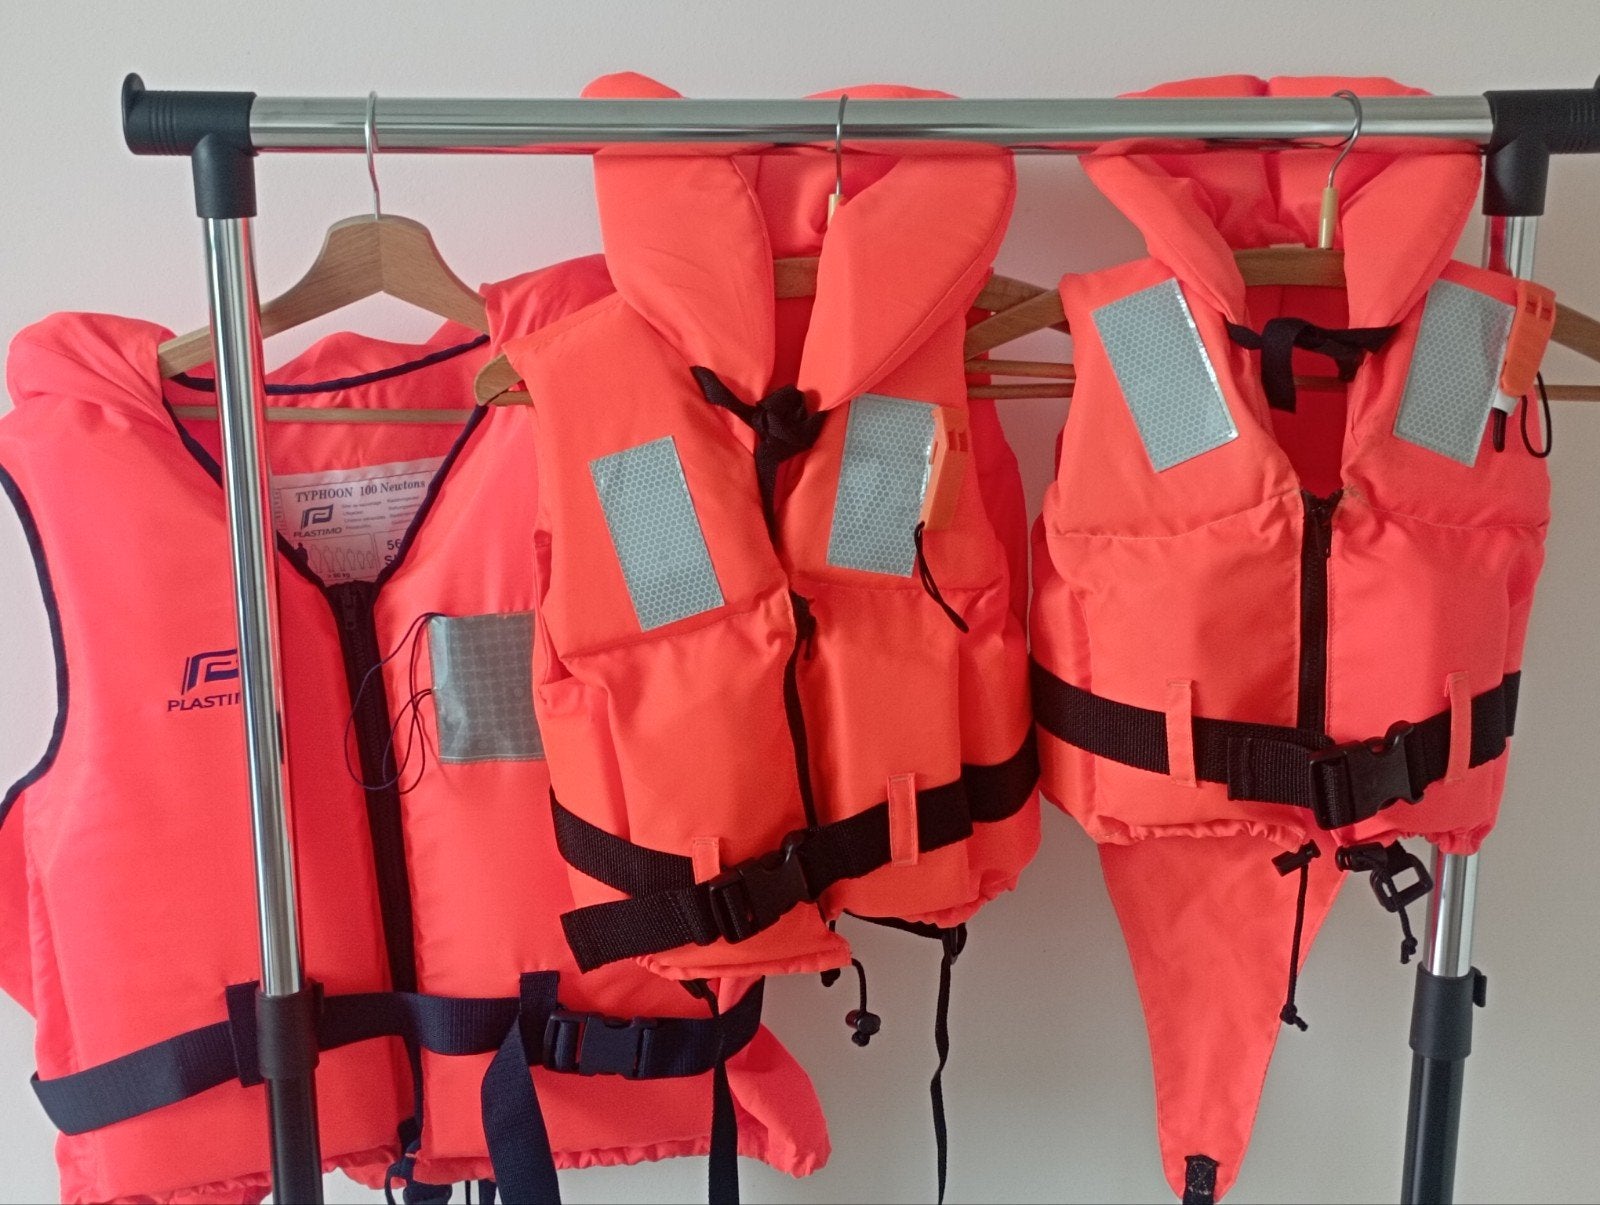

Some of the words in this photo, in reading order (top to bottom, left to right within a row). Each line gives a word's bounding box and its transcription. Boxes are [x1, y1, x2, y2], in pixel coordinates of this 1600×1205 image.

[296, 487, 353, 503] TYPHOON
[360, 485, 378, 497] 100
[380, 480, 426, 494] Newtons
[293, 527, 342, 538] PLASTIMO
[167, 693, 241, 712] PLASTI
